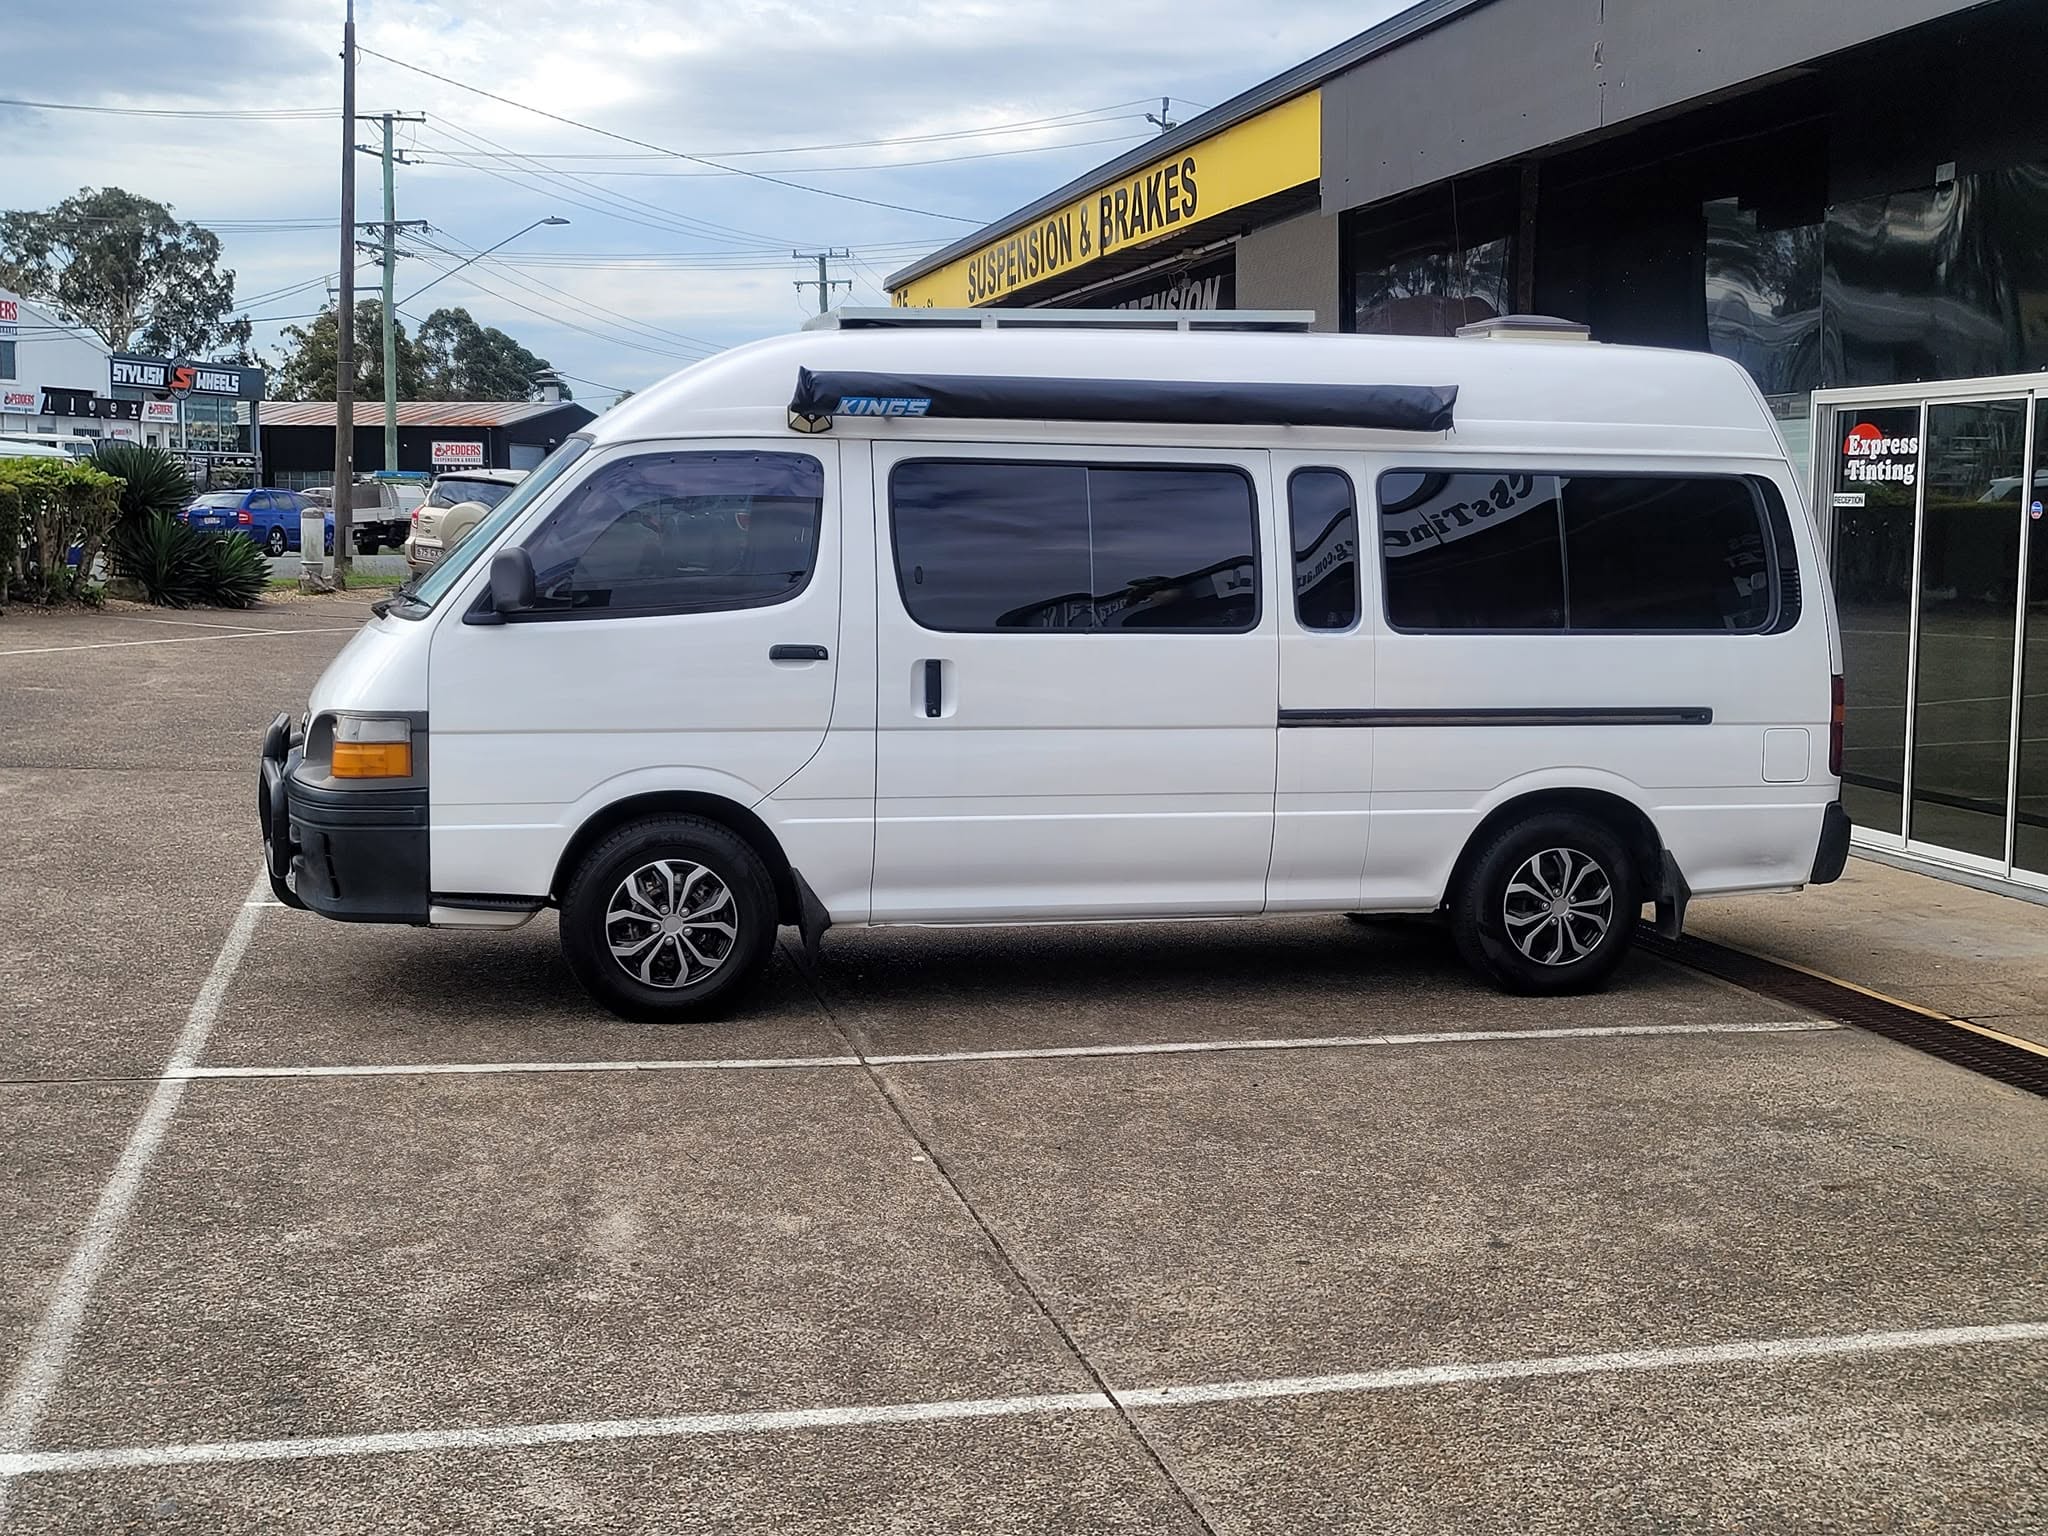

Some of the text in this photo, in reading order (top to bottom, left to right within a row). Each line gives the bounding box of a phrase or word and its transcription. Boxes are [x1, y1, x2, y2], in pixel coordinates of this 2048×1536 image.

[968, 157, 1198, 303] SUSPENSION & BRAKES
[113, 363, 165, 386] STYLISH
[196, 371, 240, 392] WHEELS
[836, 399, 931, 416] KINGS
[445, 444, 481, 456] PEDDERS
[1848, 434, 1918, 459] Express
[1847, 459, 1915, 485] Tinting
[1834, 496, 1863, 504] RECEPTION
